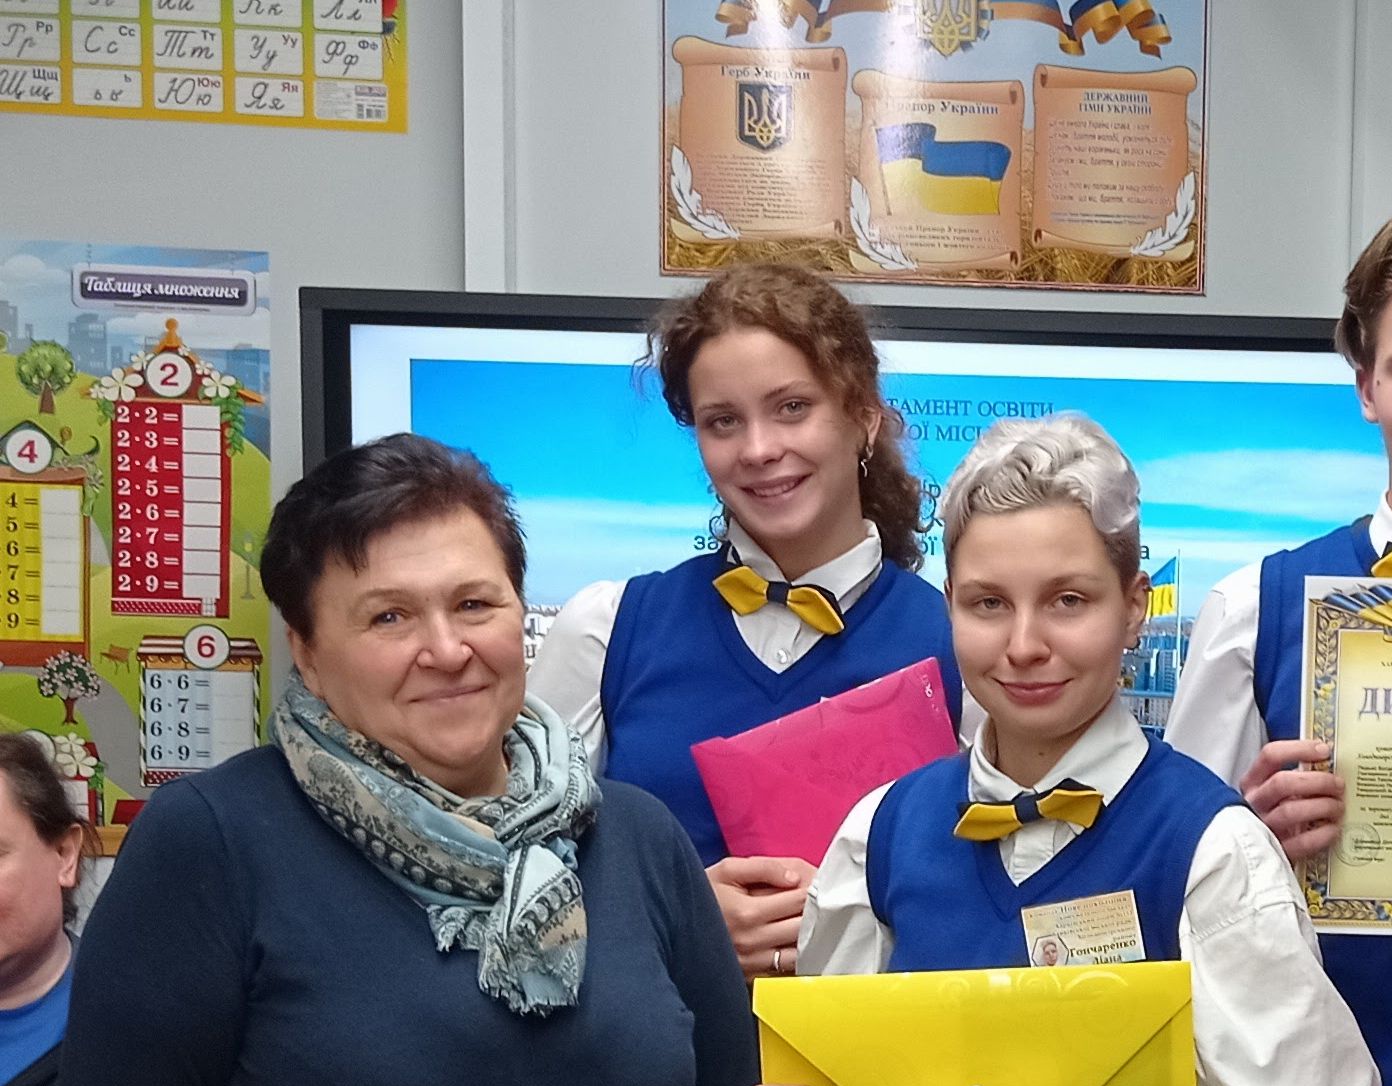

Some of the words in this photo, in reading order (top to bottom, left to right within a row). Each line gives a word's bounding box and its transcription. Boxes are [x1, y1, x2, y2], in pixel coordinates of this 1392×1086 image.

[940, 101, 999, 116] України
[85, 275, 152, 298] Таблиця
[154, 282, 240, 299] множення
[160, 363, 179, 387] 2
[117, 405, 130, 423] 2
[145, 407, 158, 424] 2
[887, 398, 973, 417] ТАМЕНТ
[977, 401, 1054, 419] ОСВІТИ
[117, 430, 131, 446] 2
[145, 431, 158, 448] 3
[17, 439, 38, 464] 4
[117, 454, 131, 471] 2
[145, 455, 158, 472] 4
[118, 478, 131, 495] 2
[145, 480, 159, 496] 5
[118, 502, 131, 519] 2
[146, 503, 159, 521] 6
[118, 526, 131, 543] 2
[146, 528, 159, 544] 7
[118, 550, 132, 567] 2
[146, 552, 159, 568] 8
[119, 574, 132, 591] 2
[146, 575, 159, 592] 9
[197, 635, 215, 658] 6
[150, 673, 162, 689] 6
[178, 674, 189, 689] 6
[150, 697, 162, 713] 6
[177, 698, 189, 713] 7
[150, 721, 162, 737] 6
[177, 722, 190, 737] 8
[150, 745, 162, 760] 6
[178, 745, 190, 761] 9
